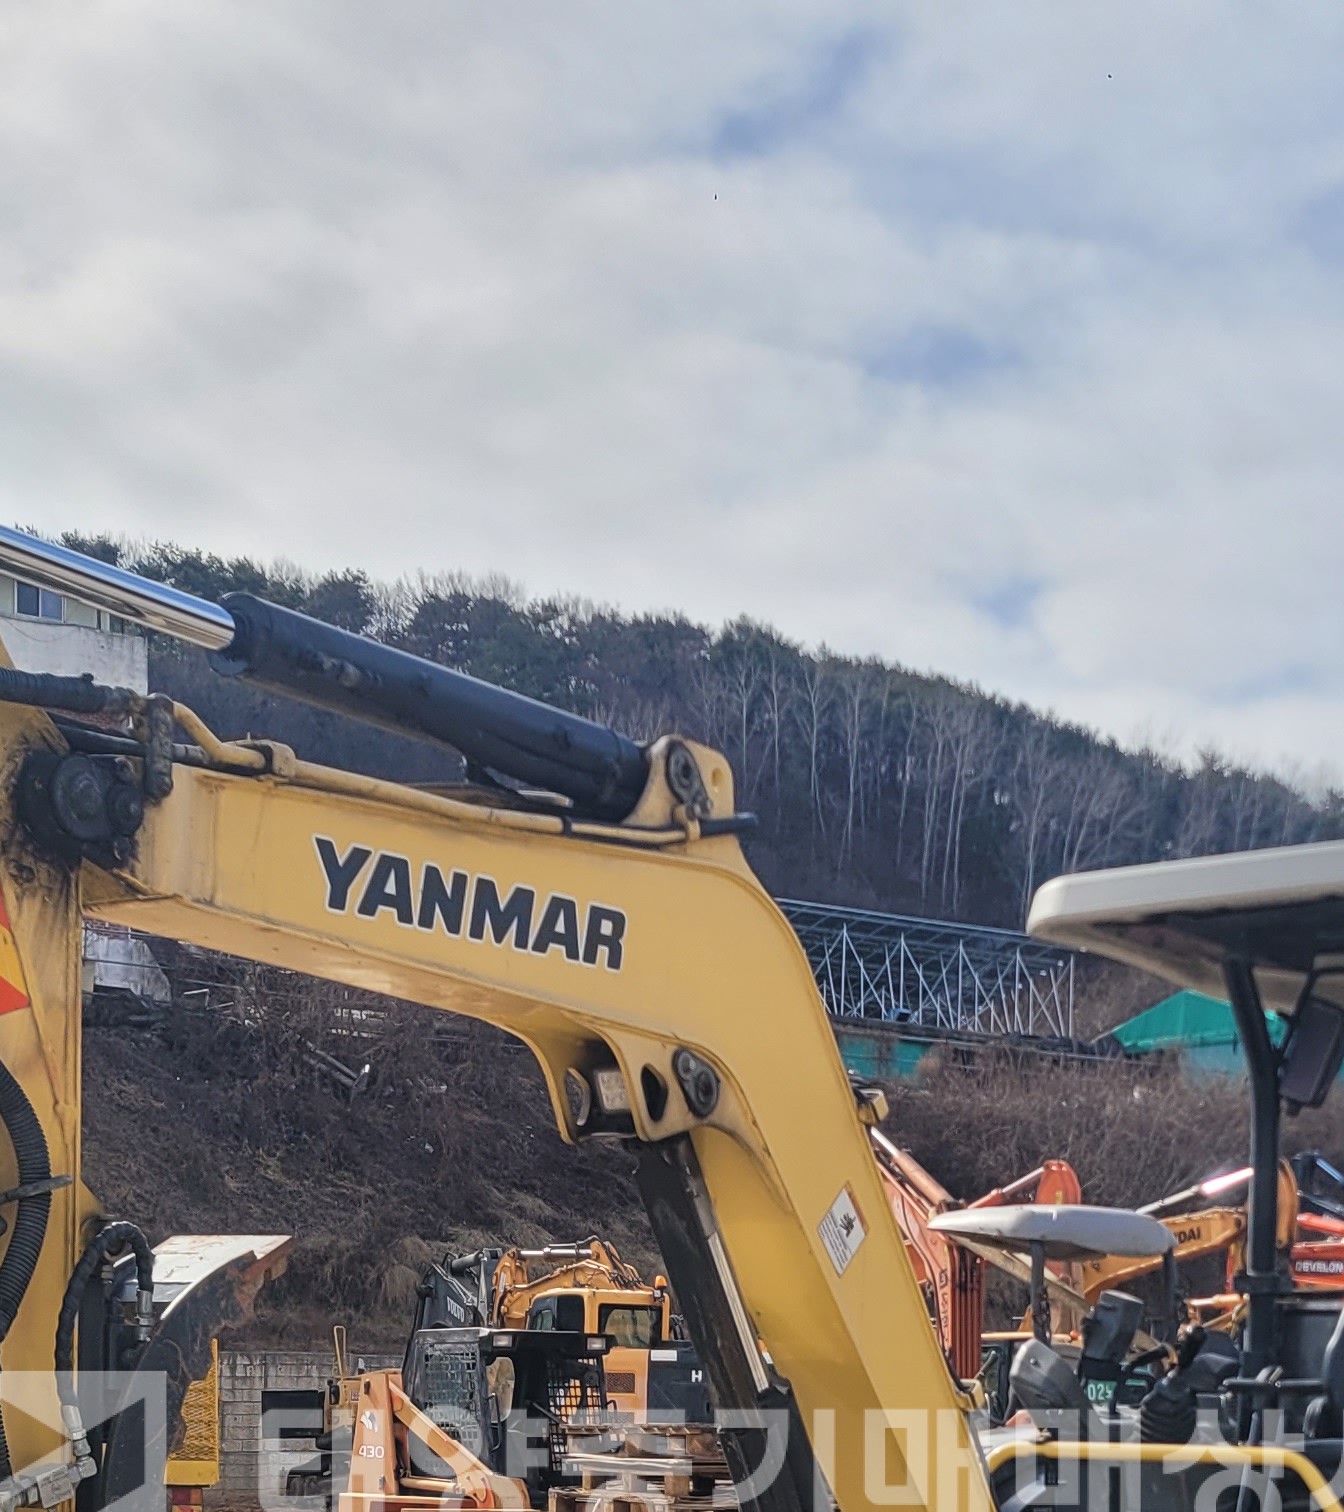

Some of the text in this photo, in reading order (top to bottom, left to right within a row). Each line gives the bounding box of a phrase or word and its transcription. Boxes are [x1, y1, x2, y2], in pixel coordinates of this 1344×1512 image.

[313, 834, 627, 972] YANMAR
[1175, 1227, 1201, 1244] DAI
[446, 1295, 465, 1323] VOLVO
[358, 1444, 385, 1459] 430
